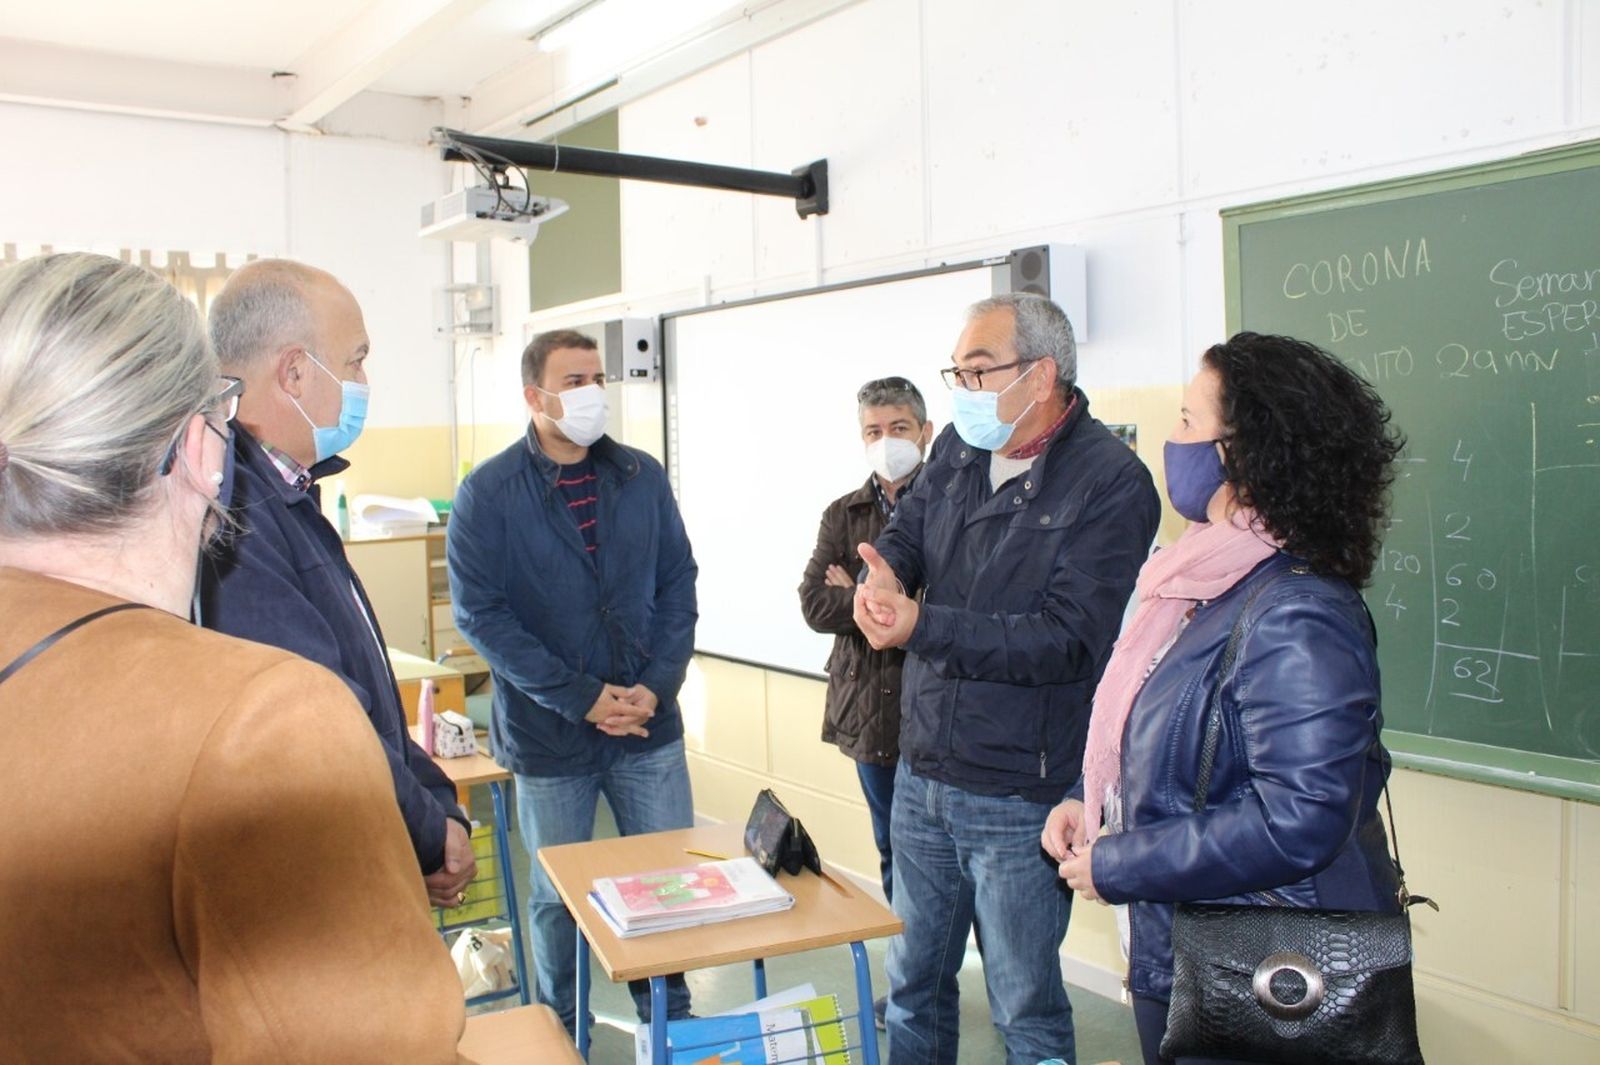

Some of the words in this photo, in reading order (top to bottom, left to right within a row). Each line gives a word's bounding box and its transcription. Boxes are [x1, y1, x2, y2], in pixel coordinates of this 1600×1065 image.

[1283, 237, 1432, 299] CORONA
[1327, 309, 1369, 342] DE
[1452, 439, 1473, 481] 4
[1444, 512, 1471, 541] 2
[1385, 583, 1407, 620] 4
[1441, 597, 1460, 626] 2
[1453, 656, 1500, 693] 62
